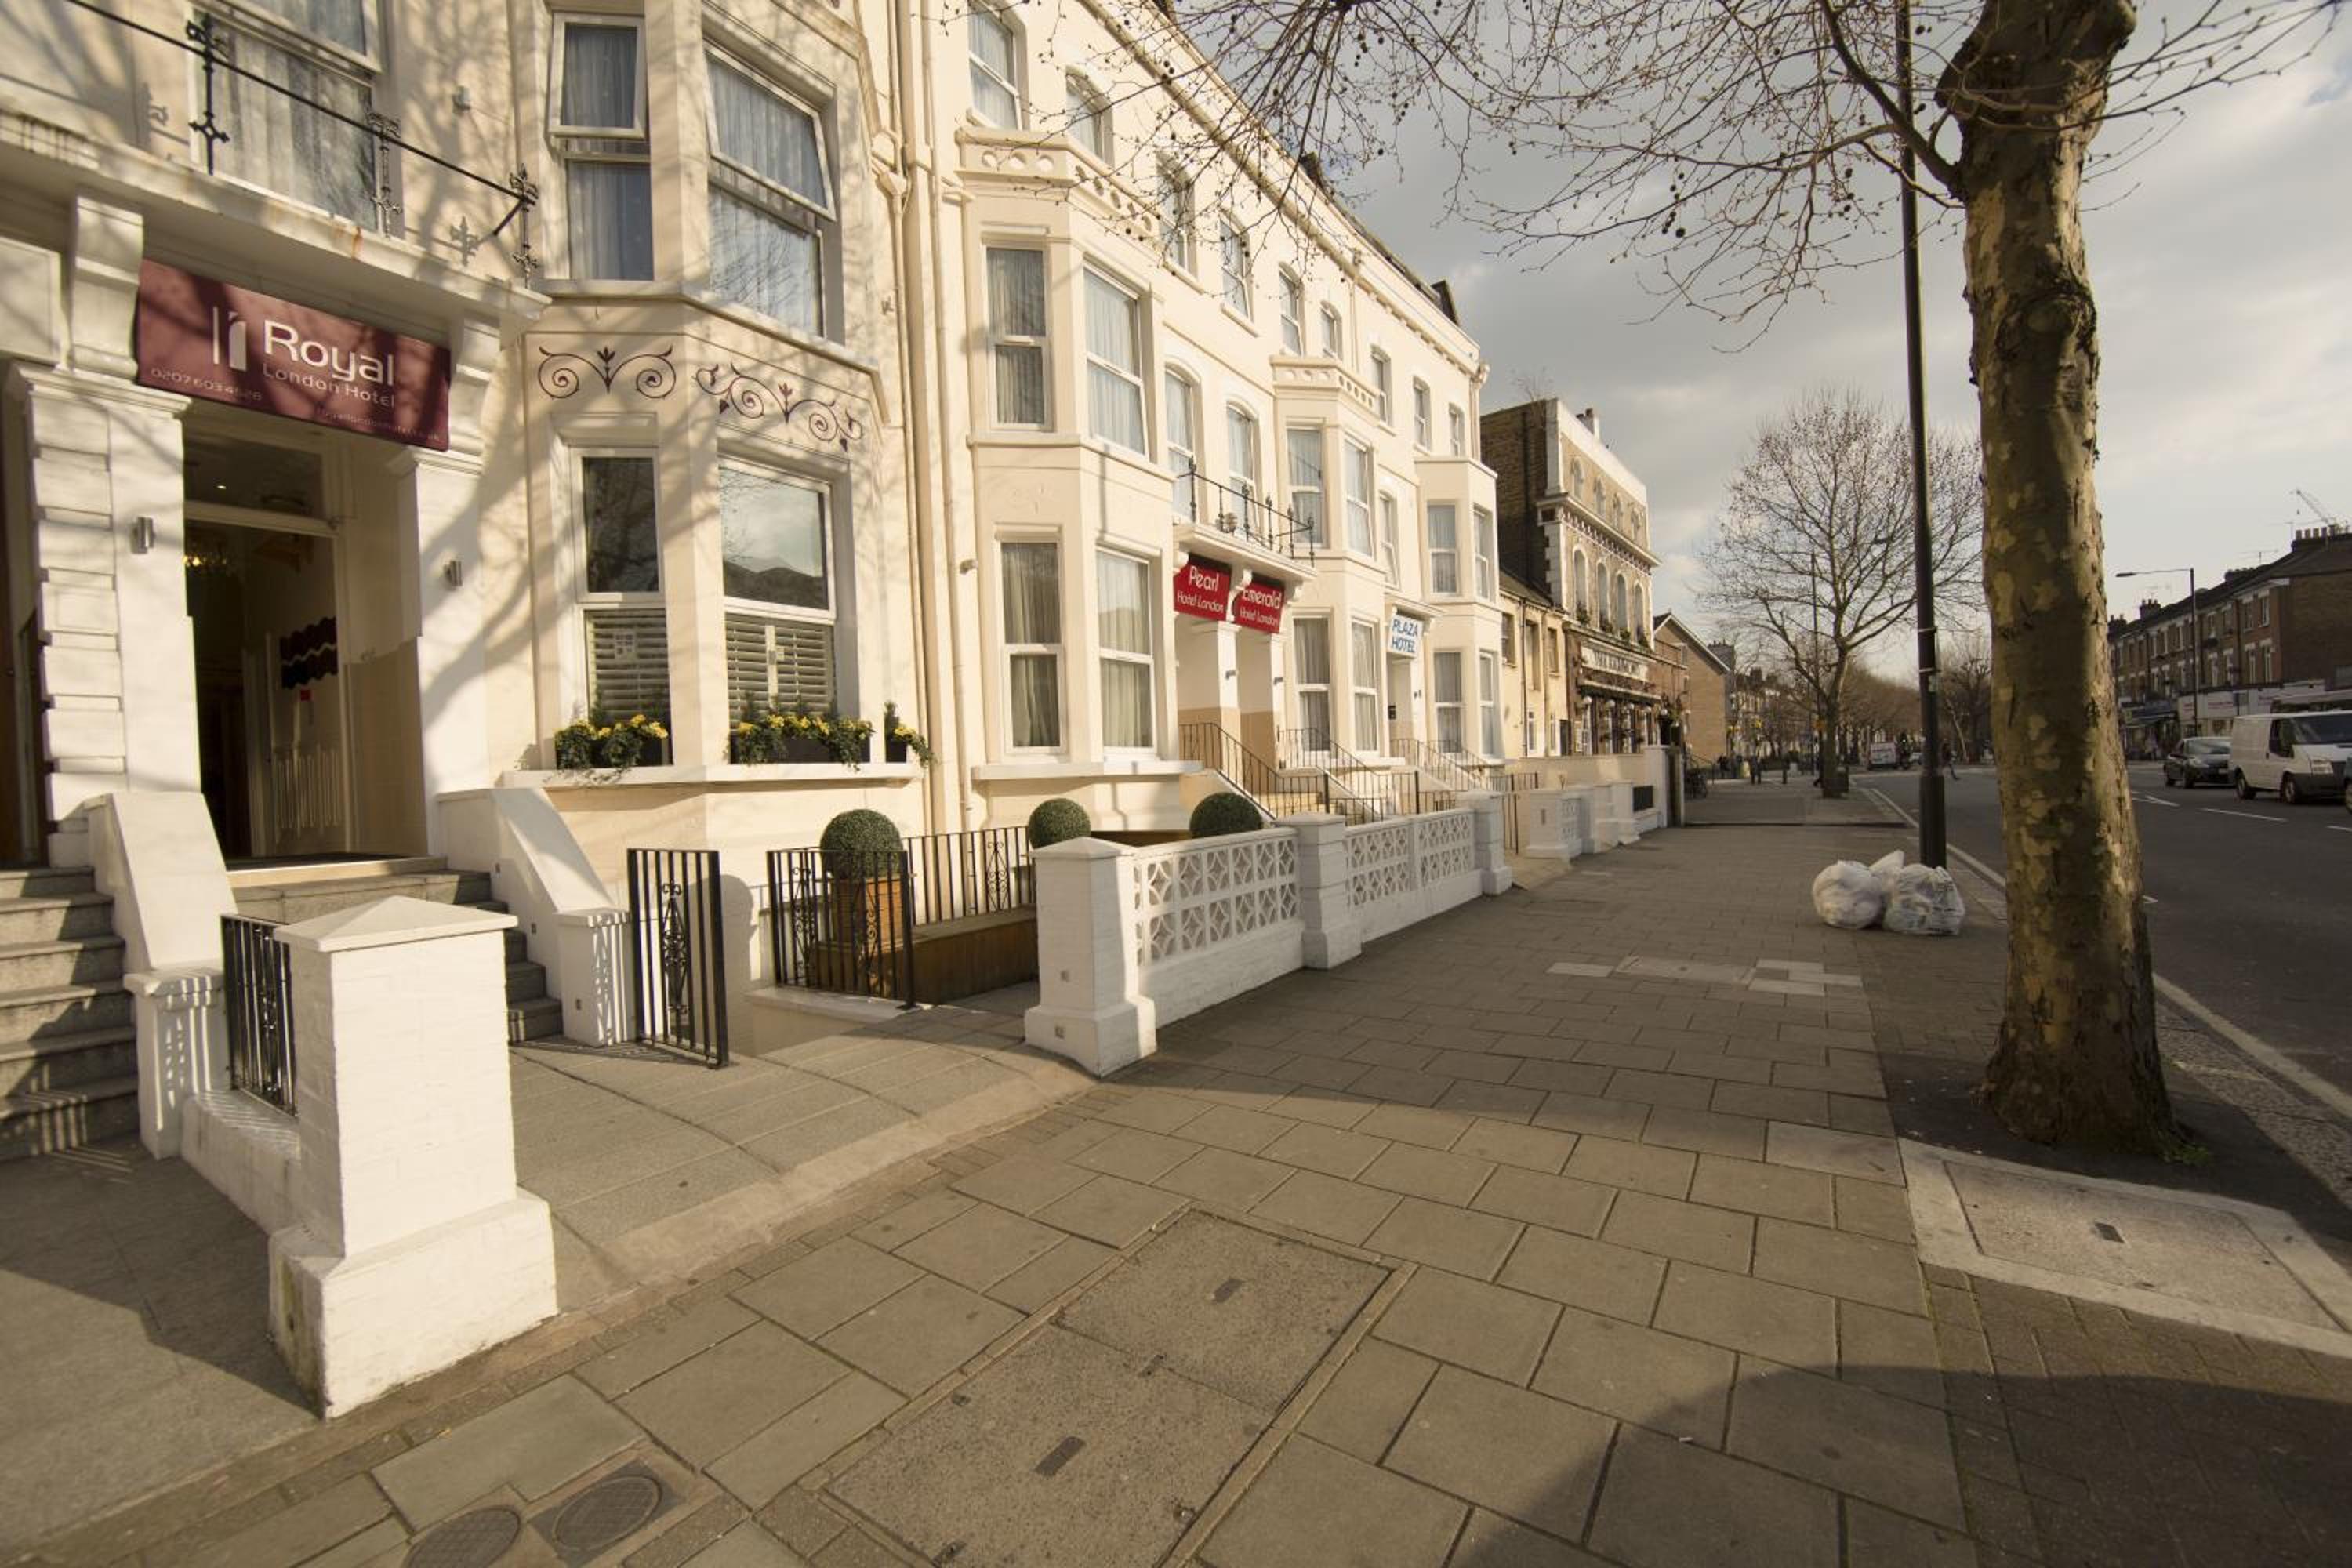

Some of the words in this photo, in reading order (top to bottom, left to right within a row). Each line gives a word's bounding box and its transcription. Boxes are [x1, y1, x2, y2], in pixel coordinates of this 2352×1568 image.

[263, 320, 394, 386] Royal
[263, 363, 339, 394] London
[345, 383, 394, 408] Hotel
[1189, 565, 1220, 592] Pearl
[1177, 590, 1197, 606] Hotel
[1197, 594, 1224, 613] London
[1241, 589, 1283, 609] Emerald
[1240, 606, 1257, 622] Hotel
[1392, 618, 1418, 637] PLAZA
[1392, 636, 1415, 653] HOTEL
